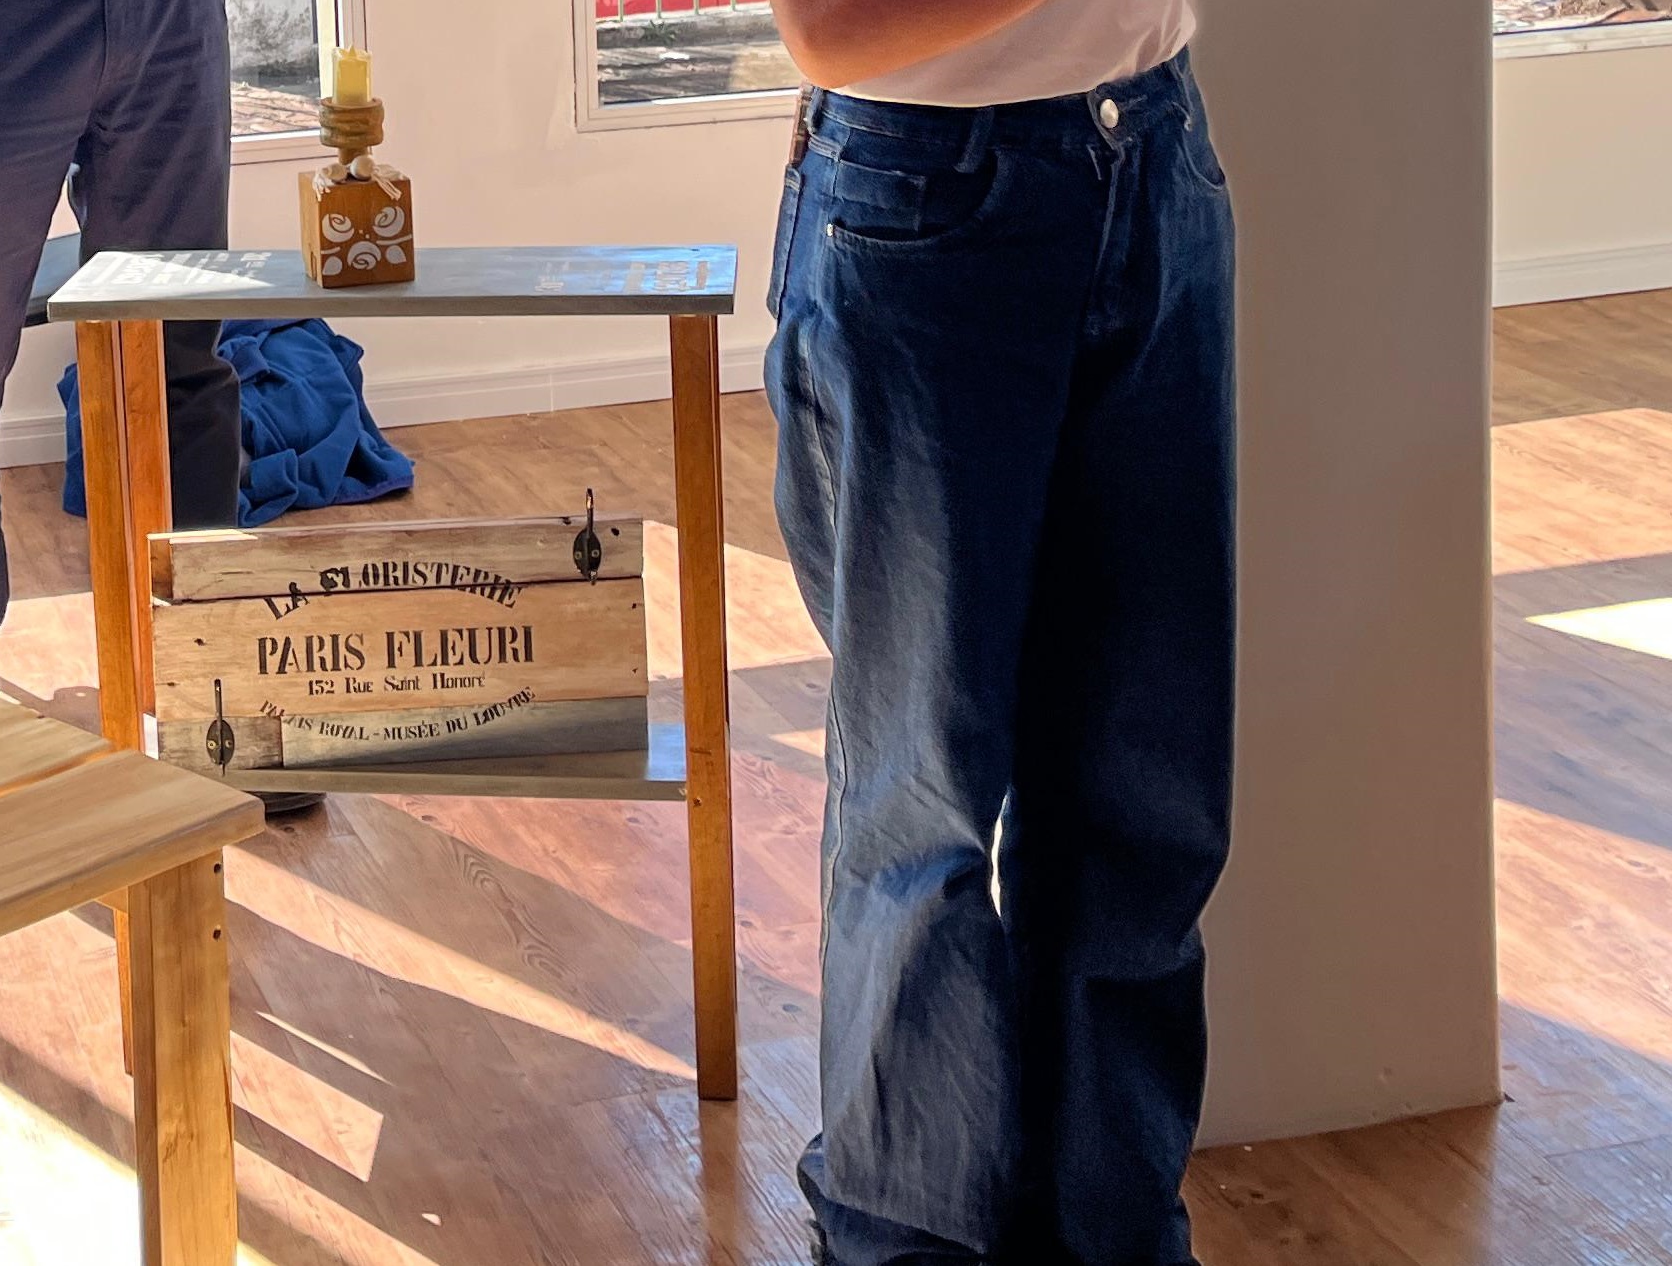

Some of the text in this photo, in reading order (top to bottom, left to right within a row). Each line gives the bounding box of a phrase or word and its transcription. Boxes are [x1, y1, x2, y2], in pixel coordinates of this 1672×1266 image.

[264, 581, 310, 620] LA
[257, 625, 534, 675] PARIS FLEURI
[308, 680, 335, 696] 152
[345, 677, 373, 694] Rue
[384, 676, 421, 692] Saint
[319, 721, 370, 741] ROYAL
[383, 720, 440, 741] MUSÉE
[446, 717, 468, 734] DU
[473, 686, 535, 727] LOUVRE
